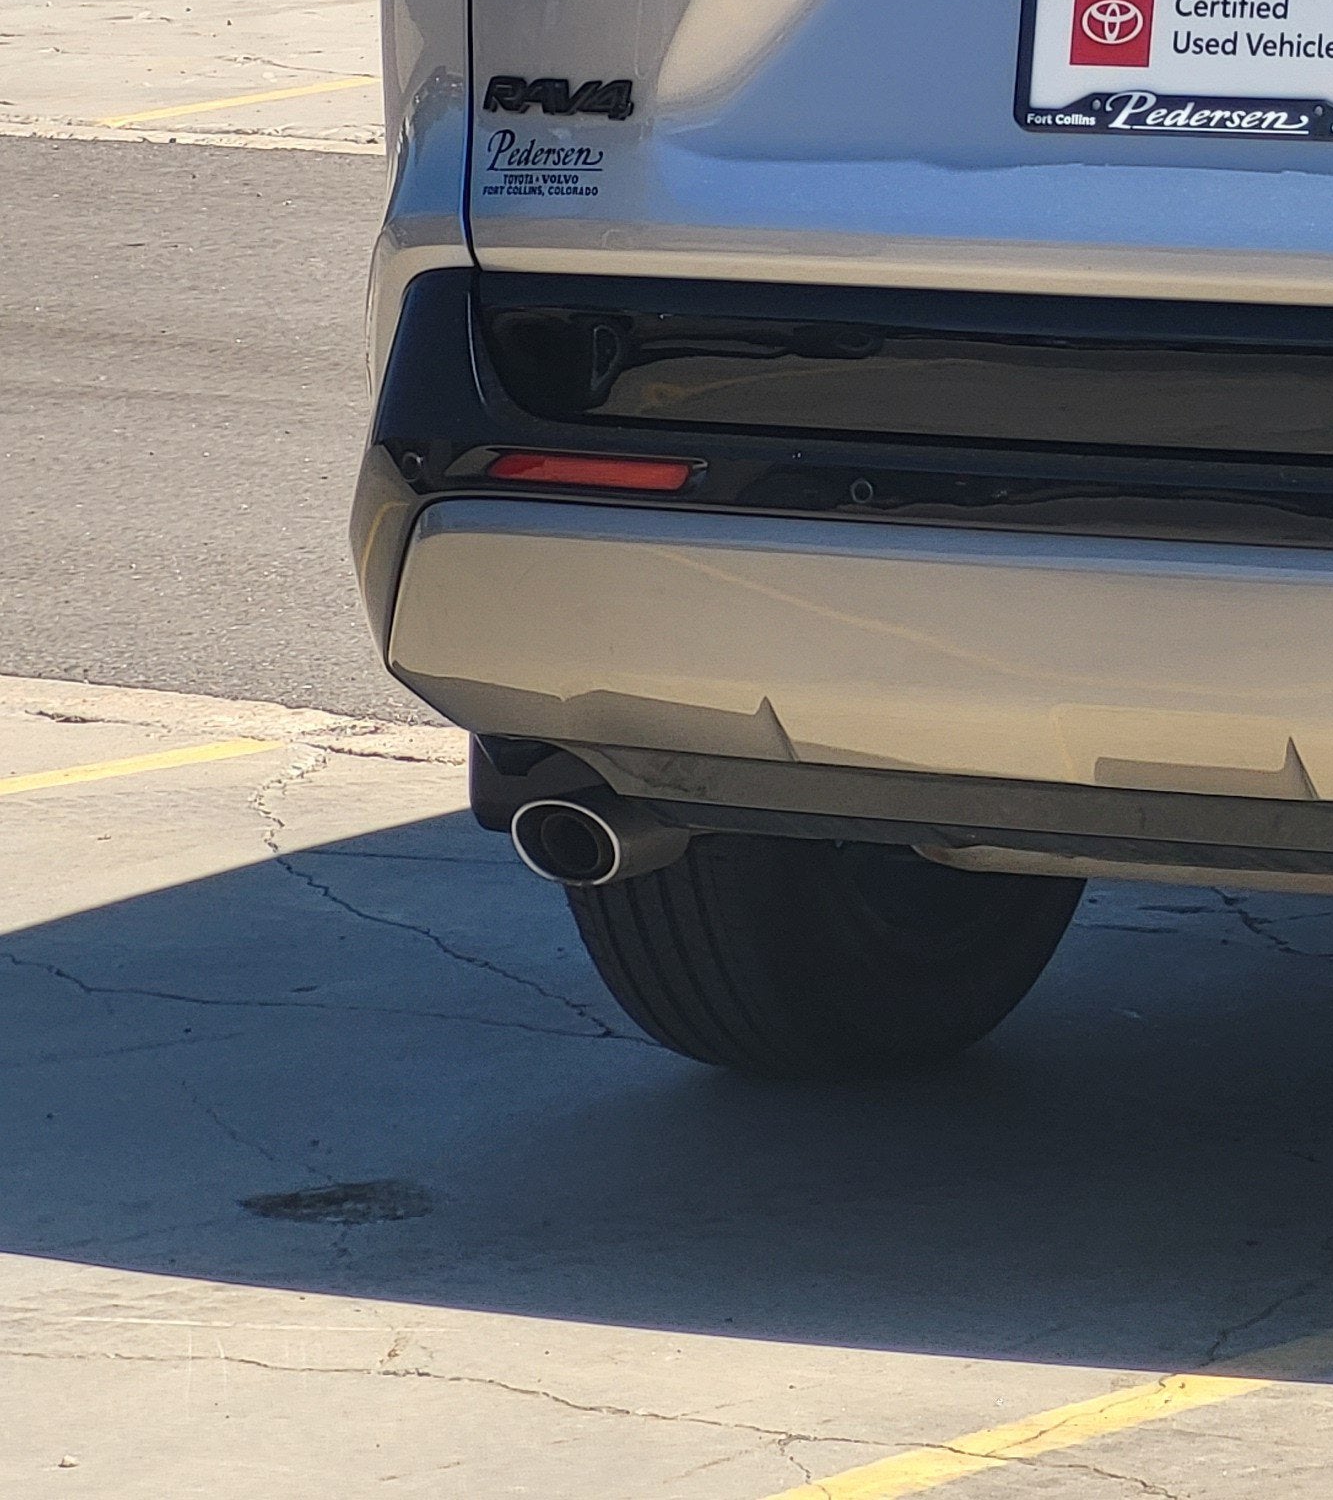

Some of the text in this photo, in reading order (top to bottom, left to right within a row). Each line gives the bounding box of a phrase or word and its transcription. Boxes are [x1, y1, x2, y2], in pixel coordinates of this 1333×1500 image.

[1172, 31, 1237, 56] Used
[483, 75, 634, 121] RAV4
[1027, 113, 1096, 126] Fort Collins
[1106, 90, 1310, 133] Pedersen
[486, 129, 604, 171] Pedersen
[482, 185, 506, 196] FORT
[547, 186, 599, 196] COLORADO
[503, 174, 579, 185] TOYOTA VOLVO
